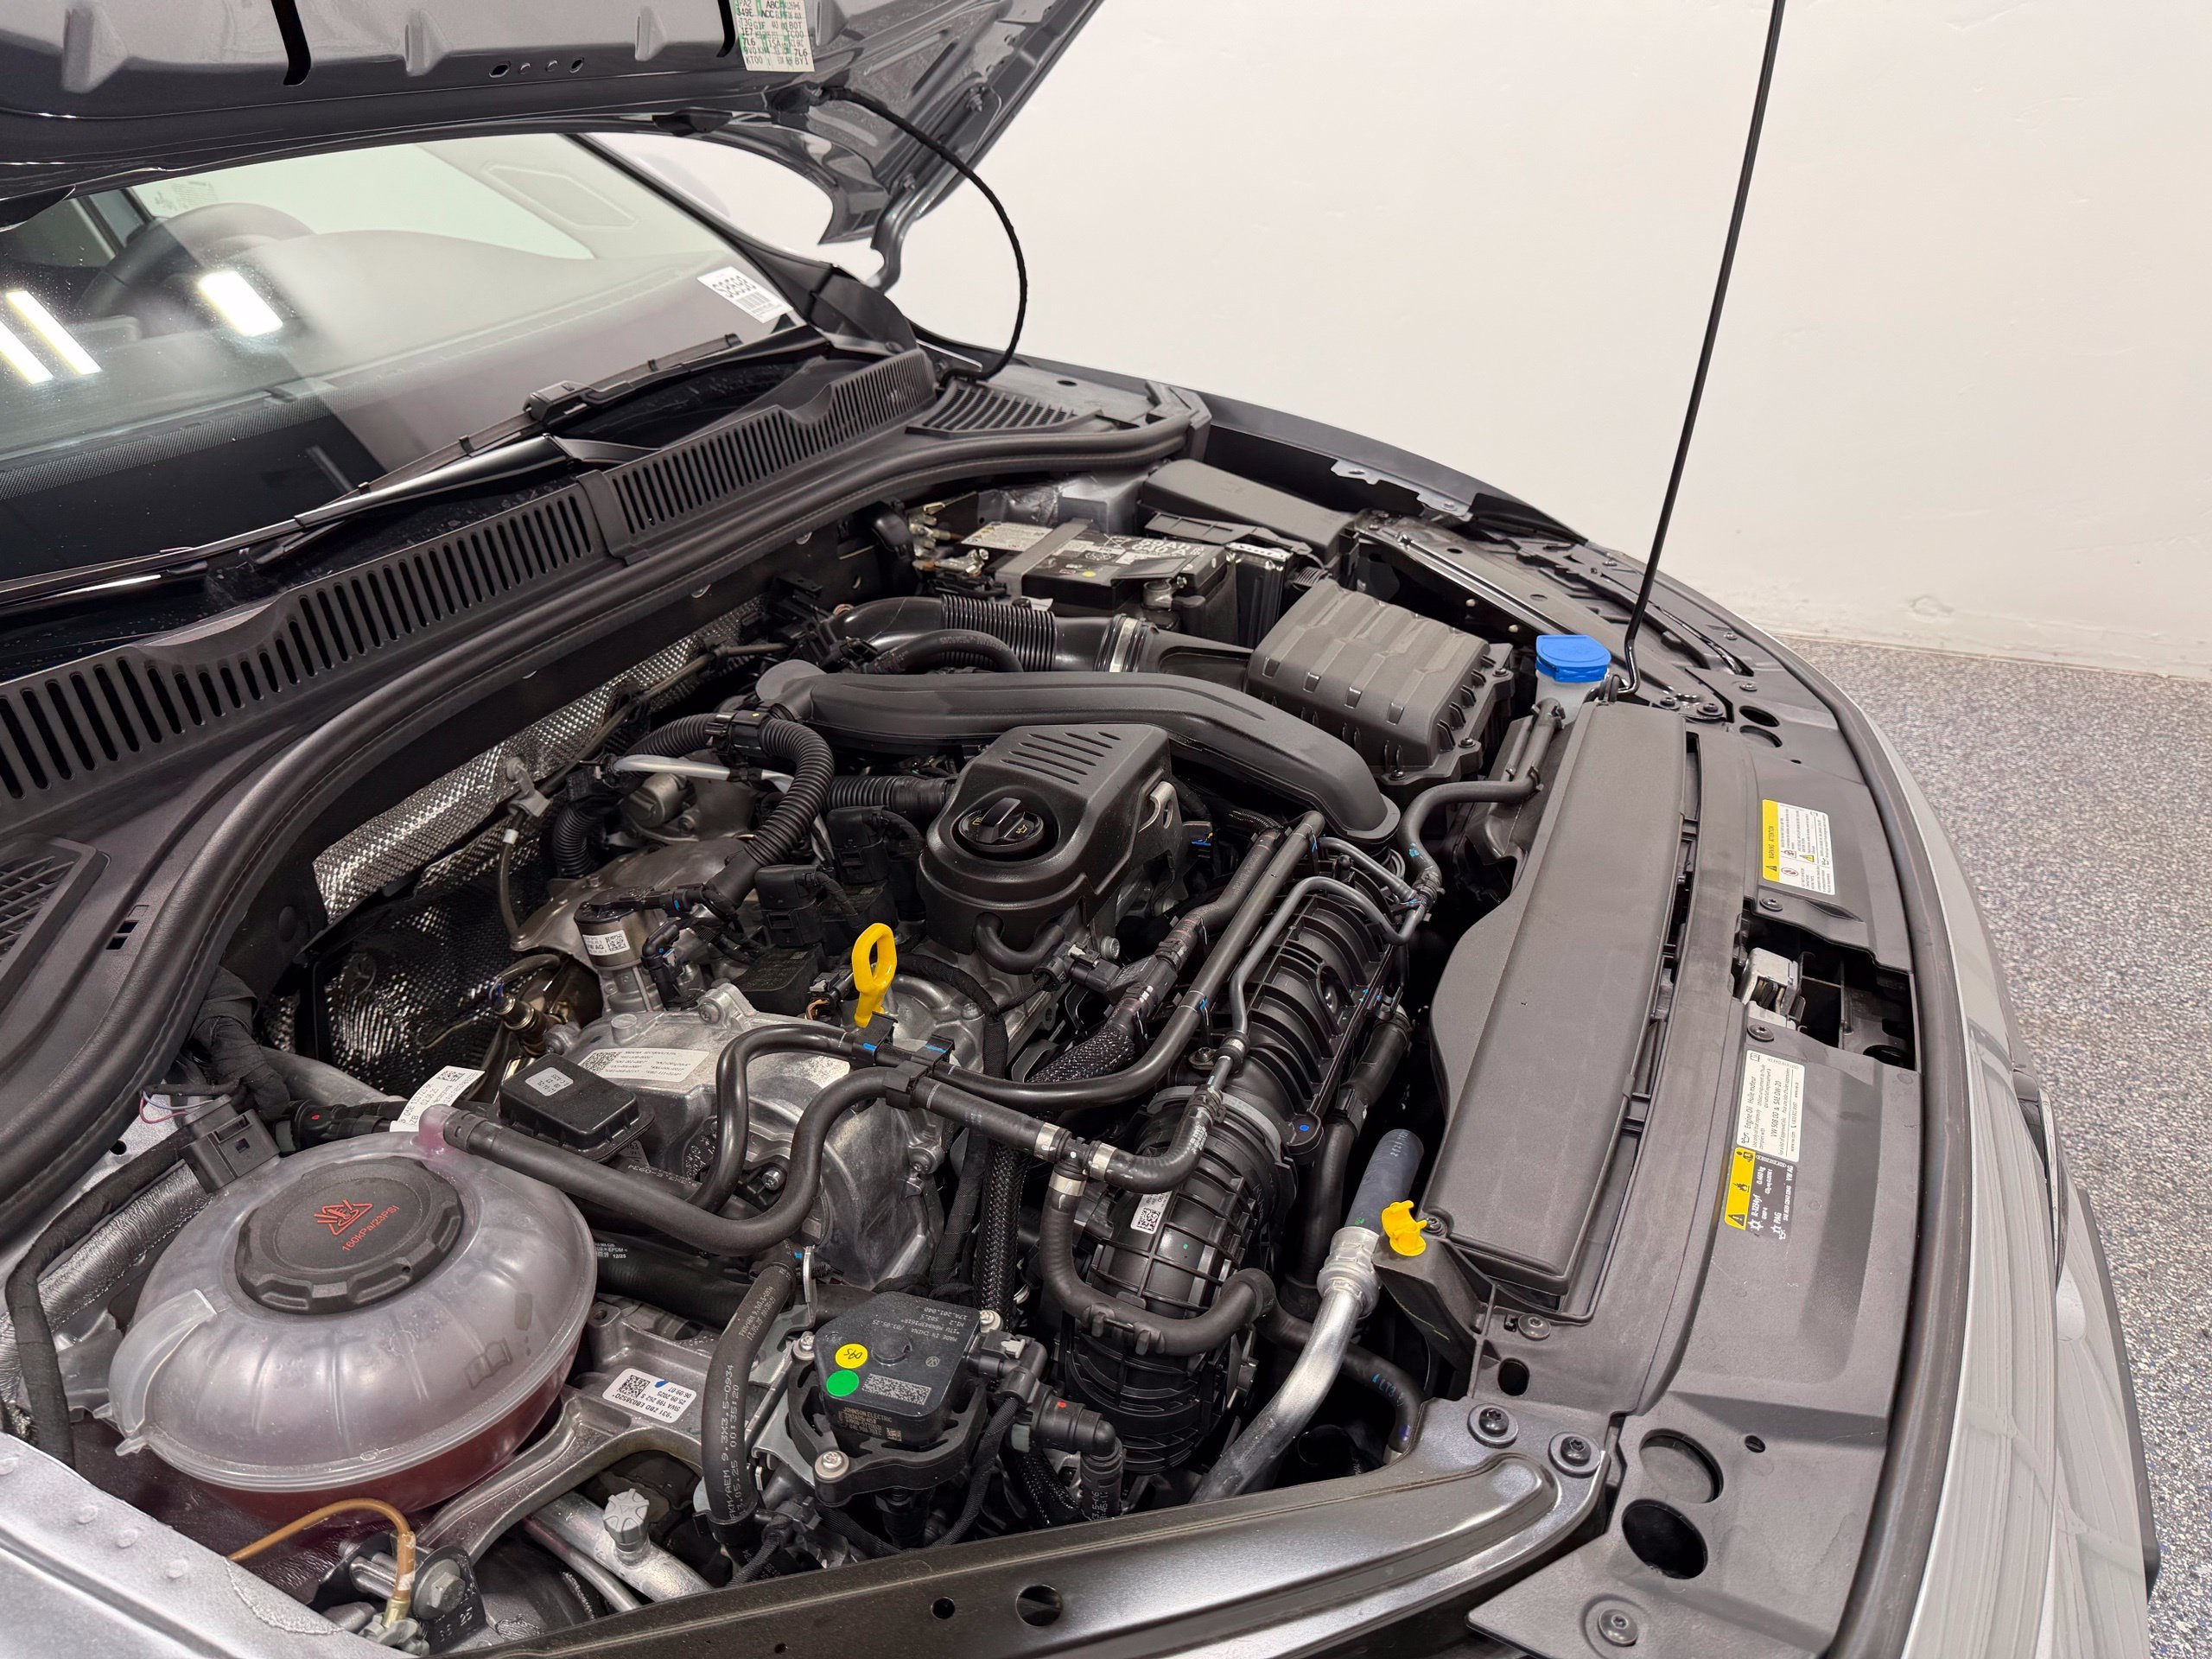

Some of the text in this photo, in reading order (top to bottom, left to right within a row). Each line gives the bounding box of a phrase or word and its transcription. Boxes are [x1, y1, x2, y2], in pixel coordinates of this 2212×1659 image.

[1746, 1075, 1757, 1104] Huile moteur
[1743, 1104, 1754, 1129] Engine Oil
[1770, 1128, 1777, 1138] VW
[1786, 1164, 1793, 1173] AG
[1785, 1172, 1793, 1181] VW
[1750, 1192, 1763, 1217] R-1234yf
[1772, 1211, 1783, 1224] PAG
[910, 1327, 930, 1337] CHINA
[942, 1333, 958, 1342] MADE
[644, 1395, 658, 1403] 262
[654, 1398, 667, 1407] 199
[655, 1390, 687, 1405] 25.09.2025
[665, 1402, 682, 1412] 5WA
[728, 1383, 741, 1447] 00:35:20
[721, 1468, 738, 1519] FKM/AEM
